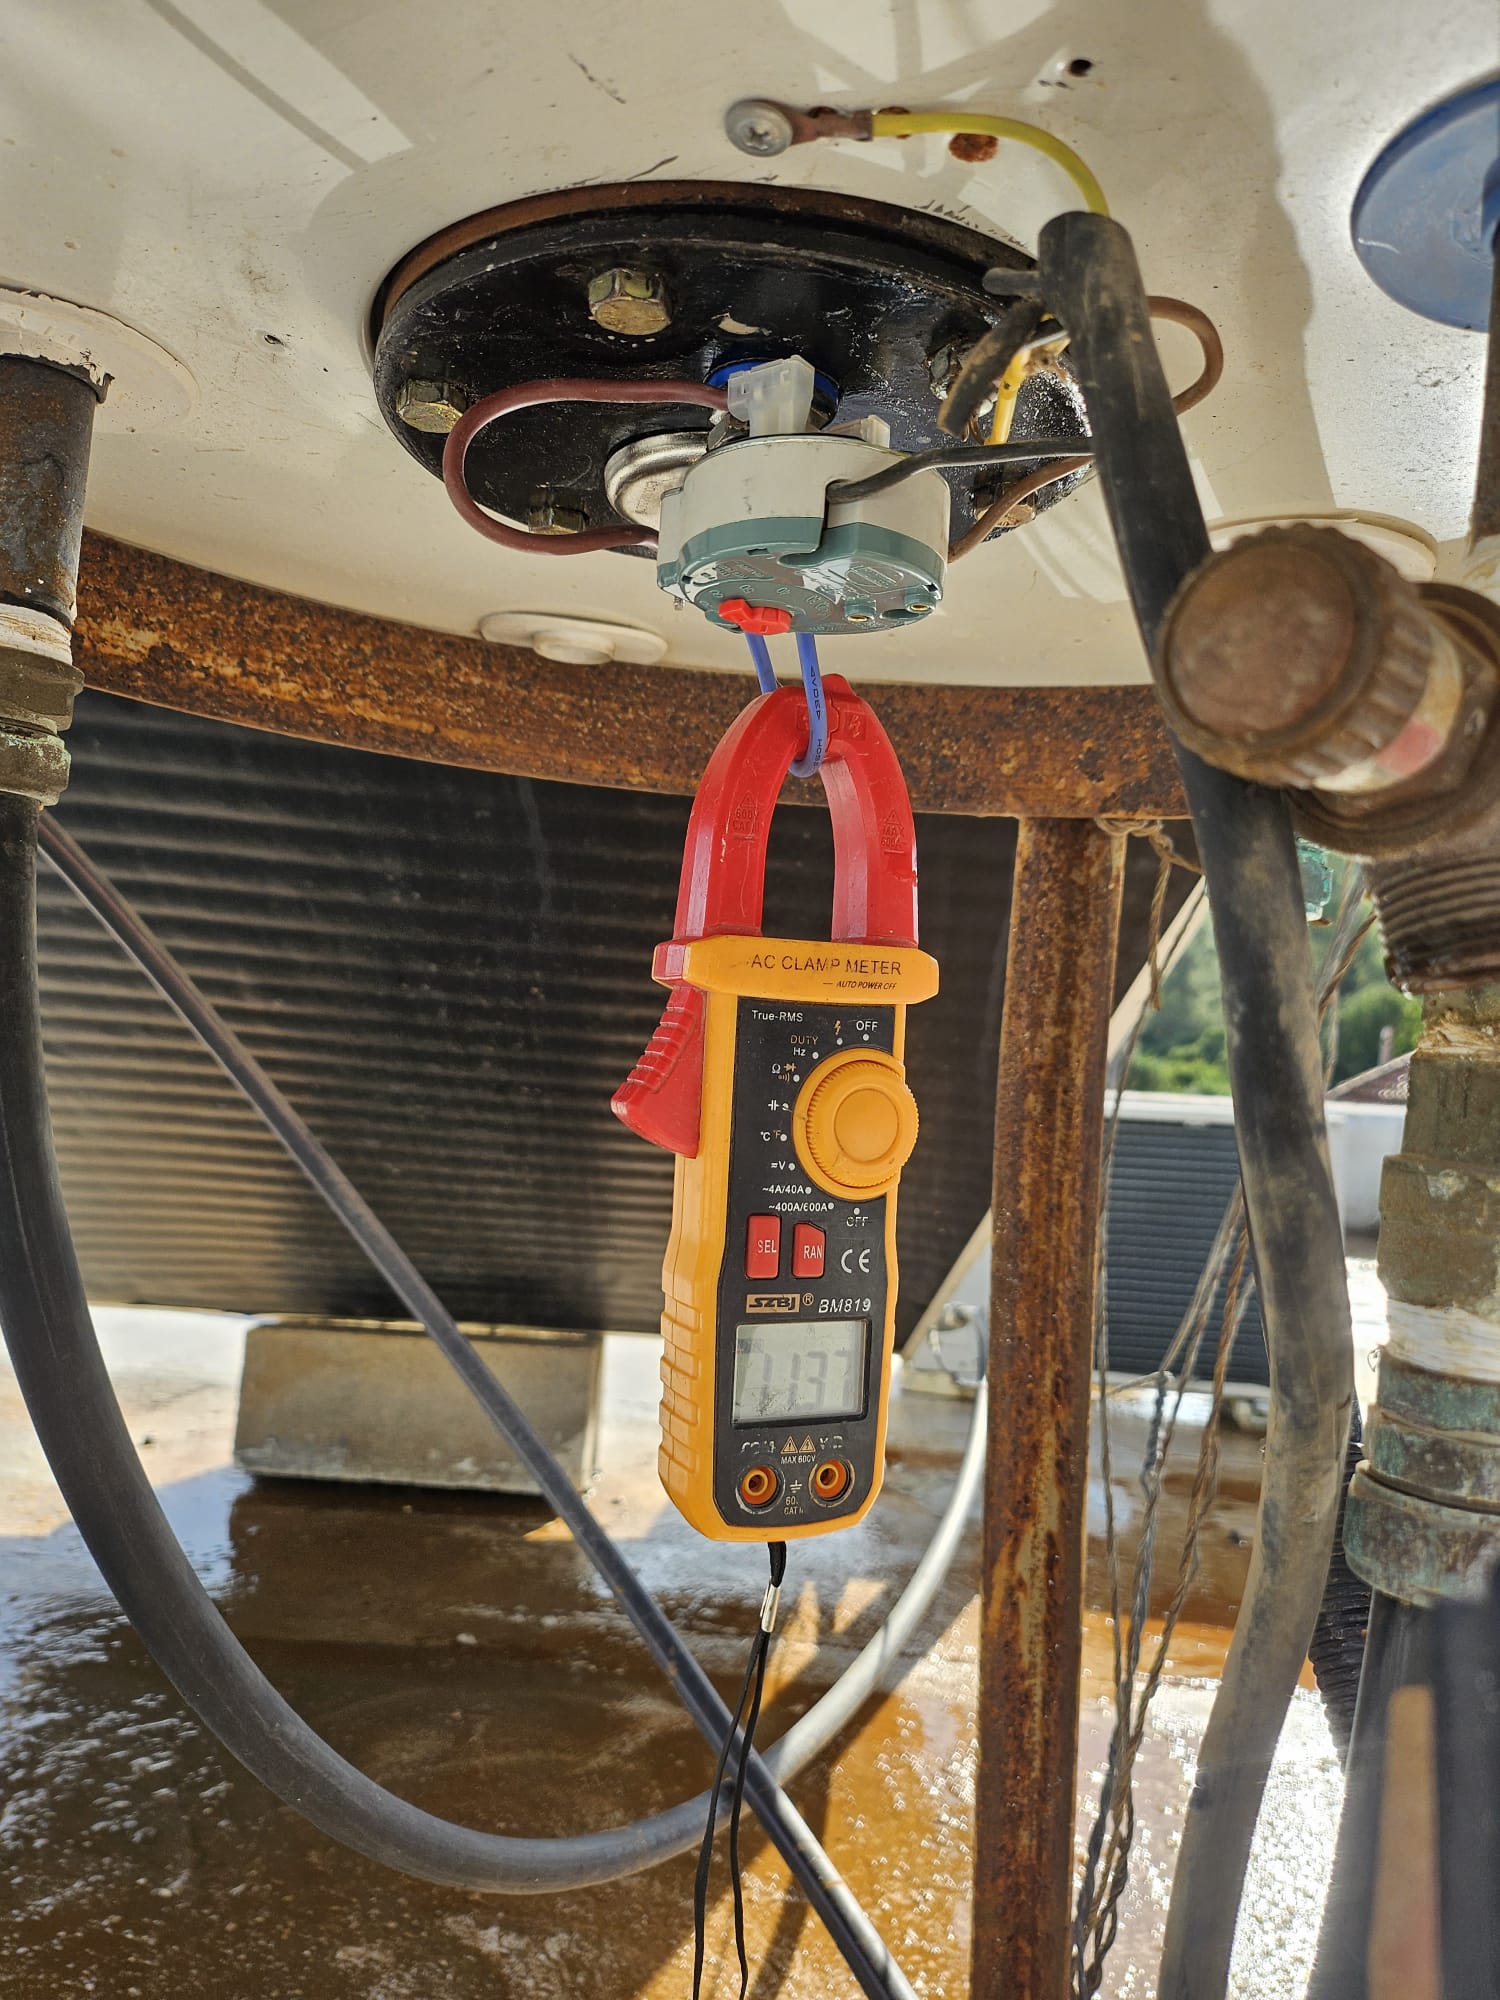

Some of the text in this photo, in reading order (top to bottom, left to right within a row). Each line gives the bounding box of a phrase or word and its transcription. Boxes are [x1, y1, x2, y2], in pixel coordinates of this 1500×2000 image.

[751, 953, 902, 975] AC CLAMP METER
[836, 980, 898, 990] AUTO POWER OFF
[751, 1009, 804, 1023] True-RMS
[855, 1019, 878, 1032] OFF
[790, 1034, 819, 1046] DUTY
[793, 1046, 806, 1058] Hz
[757, 1239, 777, 1254] SEL
[803, 1244, 823, 1260] RAN
[841, 1248, 871, 1274] CE
[818, 1298, 872, 1314] BM819
[780, 1456, 797, 1465] MAX
[784, 1506, 798, 1516] CAT
